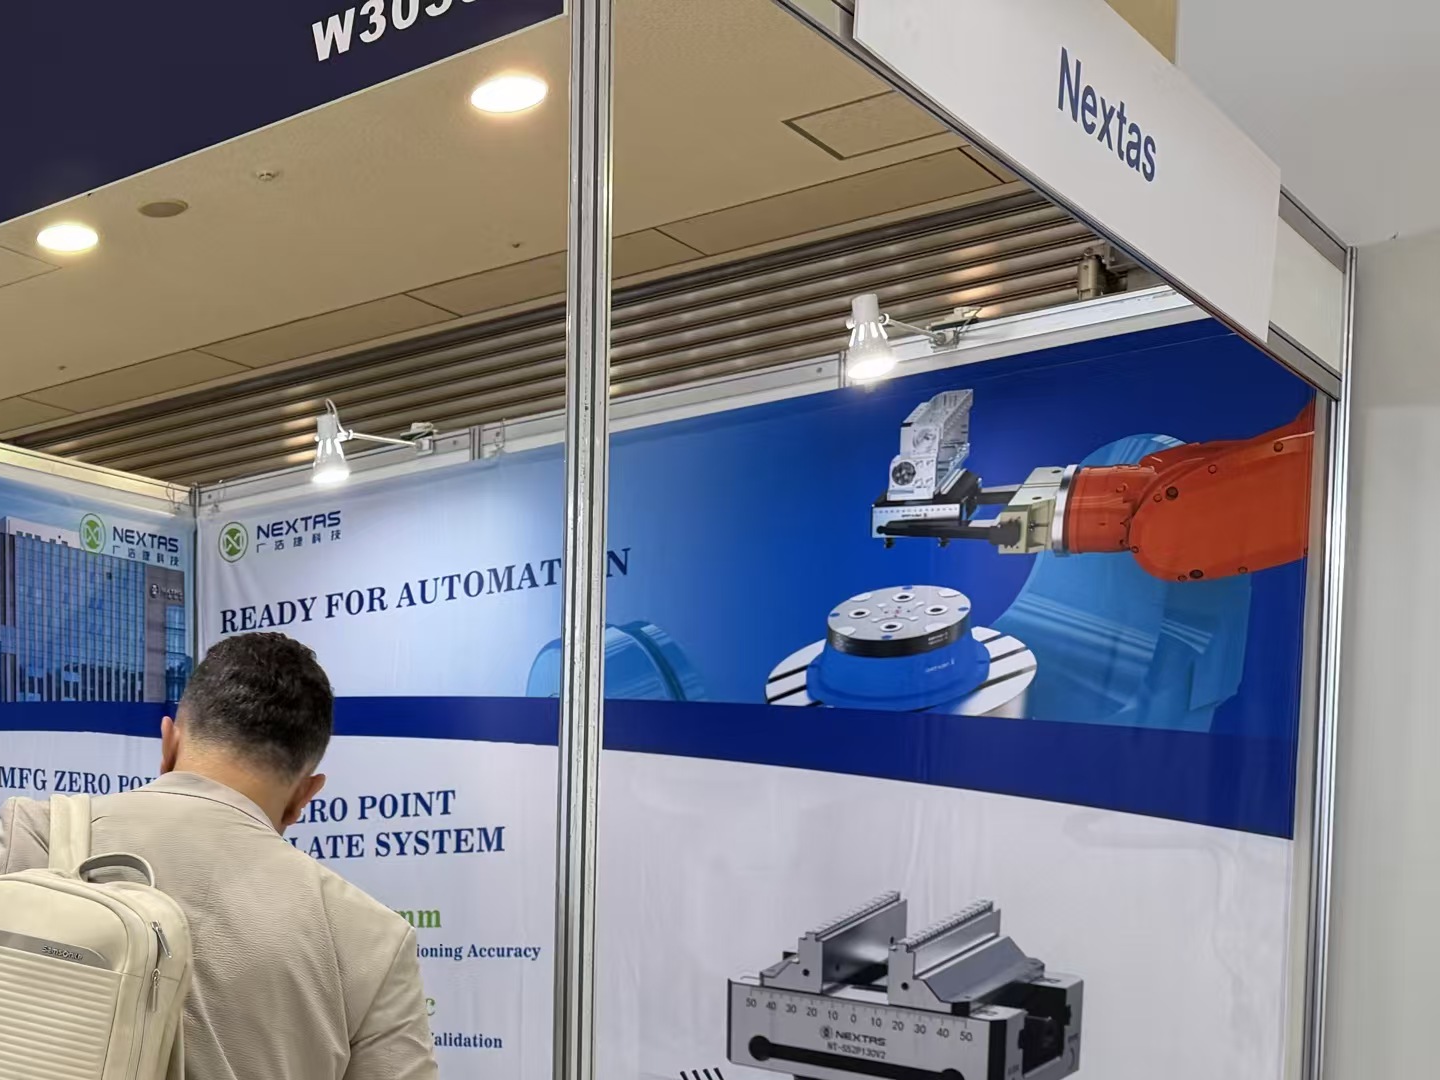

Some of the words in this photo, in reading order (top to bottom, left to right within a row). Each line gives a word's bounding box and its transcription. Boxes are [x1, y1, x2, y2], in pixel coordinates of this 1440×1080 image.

[1058, 46, 1156, 182] Nextas
[112, 526, 179, 553] NEXTAS
[256, 510, 342, 540] NEXTAS
[220, 596, 318, 634] READY
[325, 585, 389, 618] FOR
[396, 547, 631, 609] AUTOMATN
[54, 770, 110, 795] ZERO
[357, 789, 456, 820] POINT
[374, 825, 506, 857] SYSTEM
[466, 943, 541, 961] Accuracy
[746, 998, 757, 1008] 50
[766, 1001, 777, 1011] 40
[786, 1004, 797, 1014] 30
[806, 1007, 818, 1017] 20
[828, 1010, 838, 1021] 10
[850, 1013, 857, 1024] 0
[871, 1017, 882, 1028] 10
[892, 1021, 904, 1031] 20
[914, 1024, 926, 1034] 30
[936, 1027, 949, 1038] 40
[960, 1031, 973, 1042] 50
[431, 1032, 503, 1048] alidation
[835, 1030, 886, 1046] NEXTAS
